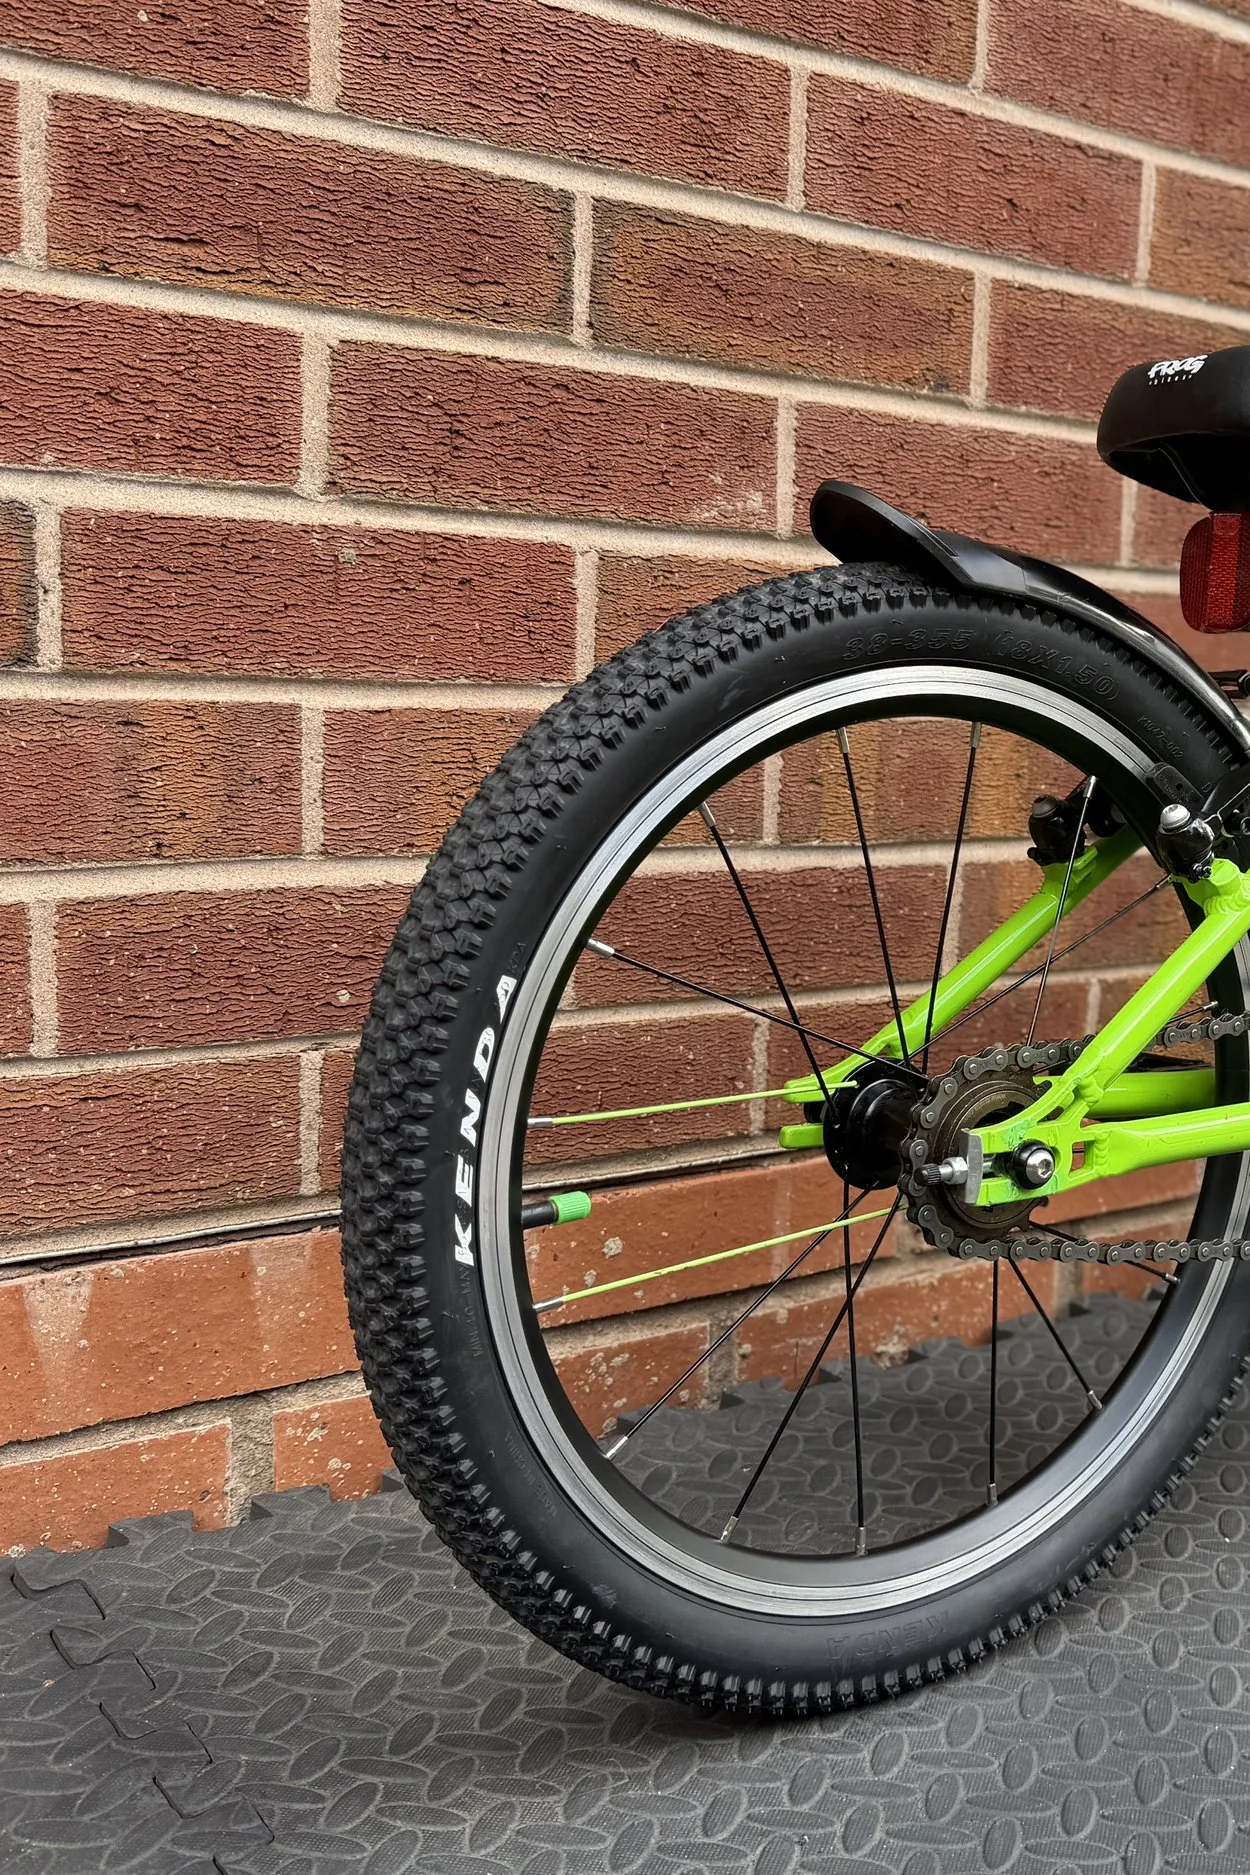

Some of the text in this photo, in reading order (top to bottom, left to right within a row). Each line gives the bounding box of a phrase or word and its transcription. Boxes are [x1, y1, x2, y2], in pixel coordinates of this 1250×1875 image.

[1147, 354, 1208, 379] FROG
[841, 629, 976, 660] 38-355
[454, 974, 517, 1267] KENDA
